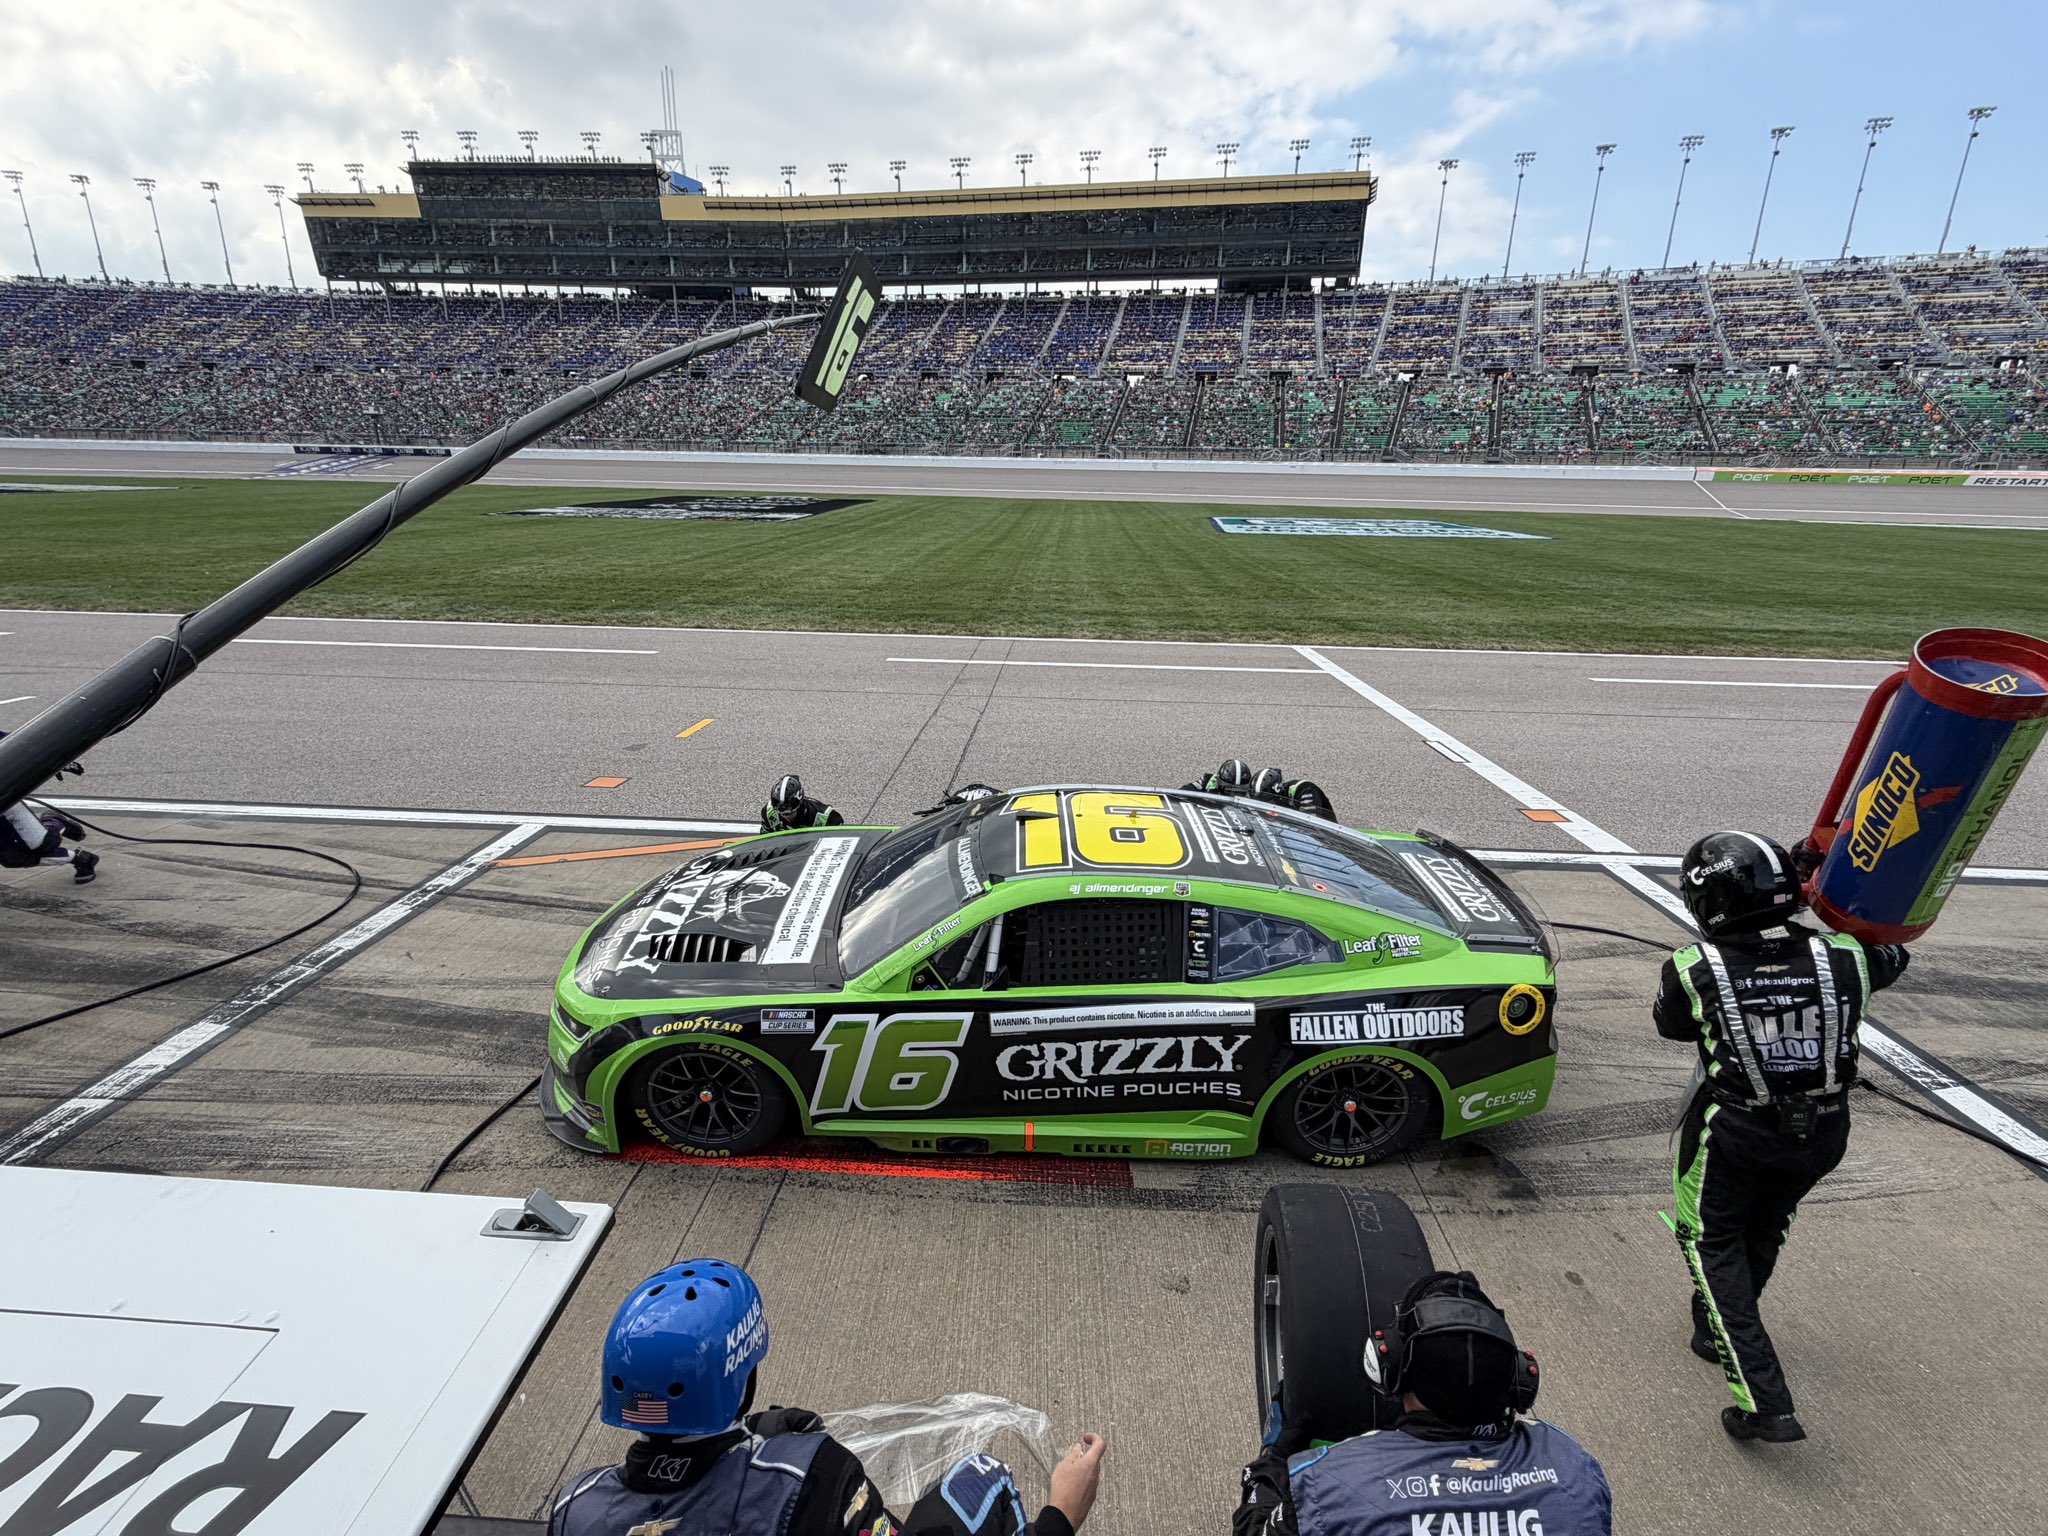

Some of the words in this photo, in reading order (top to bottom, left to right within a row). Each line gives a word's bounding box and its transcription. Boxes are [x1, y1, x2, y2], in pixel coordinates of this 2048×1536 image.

[814, 275, 875, 396] 16
[1733, 473, 1774, 482] POET
[1789, 474, 1831, 483] POET
[1848, 475, 1892, 484] POET
[1908, 476, 1954, 485] POET
[1852, 756, 1916, 867] SUNOCO
[1000, 790, 1193, 873] 16
[1197, 804, 1249, 865] GRIZZLY
[1701, 858, 1735, 876] CELSIUS
[815, 874, 833, 898] product
[1085, 883, 1168, 895] allmendinger
[1417, 853, 1500, 922] GRIZZLY
[803, 896, 822, 924] contains
[776, 906, 802, 944] chemical.
[790, 924, 814, 960] nicotine.
[1344, 936, 1377, 954] Leaf
[1388, 933, 1421, 948] Filter
[1366, 1003, 1386, 1013] THE
[1767, 995, 1793, 1006] THE
[652, 1016, 743, 1036] GOODYEAR
[768, 1021, 782, 1029] CUP
[783, 1021, 807, 1029] SERIES
[777, 1011, 807, 1019] NASCAR
[993, 1016, 1032, 1027] WARNING:
[1033, 1016, 1048, 1025] This
[1049, 1015, 1076, 1026] product
[1077, 1013, 1106, 1023] contains
[1107, 1011, 1136, 1020] nicotine.
[1137, 1010, 1167, 1019] Nicotine
[1168, 1009, 1174, 1017] is
[1185, 1009, 1218, 1018] addictive
[1218, 1008, 1252, 1017] chemical.
[1290, 1015, 1359, 1041] FALLEN
[1363, 1009, 1464, 1039] OUTDOORS
[698, 1042, 754, 1068] EAGLE
[809, 1011, 975, 1117] 16
[995, 1035, 1252, 1084] GRIZZLY
[1003, 1084, 1116, 1101] NICOTINE
[1124, 1082, 1241, 1097] POUCHES
[1485, 1089, 1537, 1108] CELSIUS
[1311, 1152, 1365, 1167] EAGLE
[726, 1296, 760, 1354] KAULIG
[724, 1316, 763, 1378] RACING
[0, 1383, 367, 1536] RAC
[648, 1455, 691, 1482] K1
[1446, 1467, 1558, 1494] @KauligRacing
